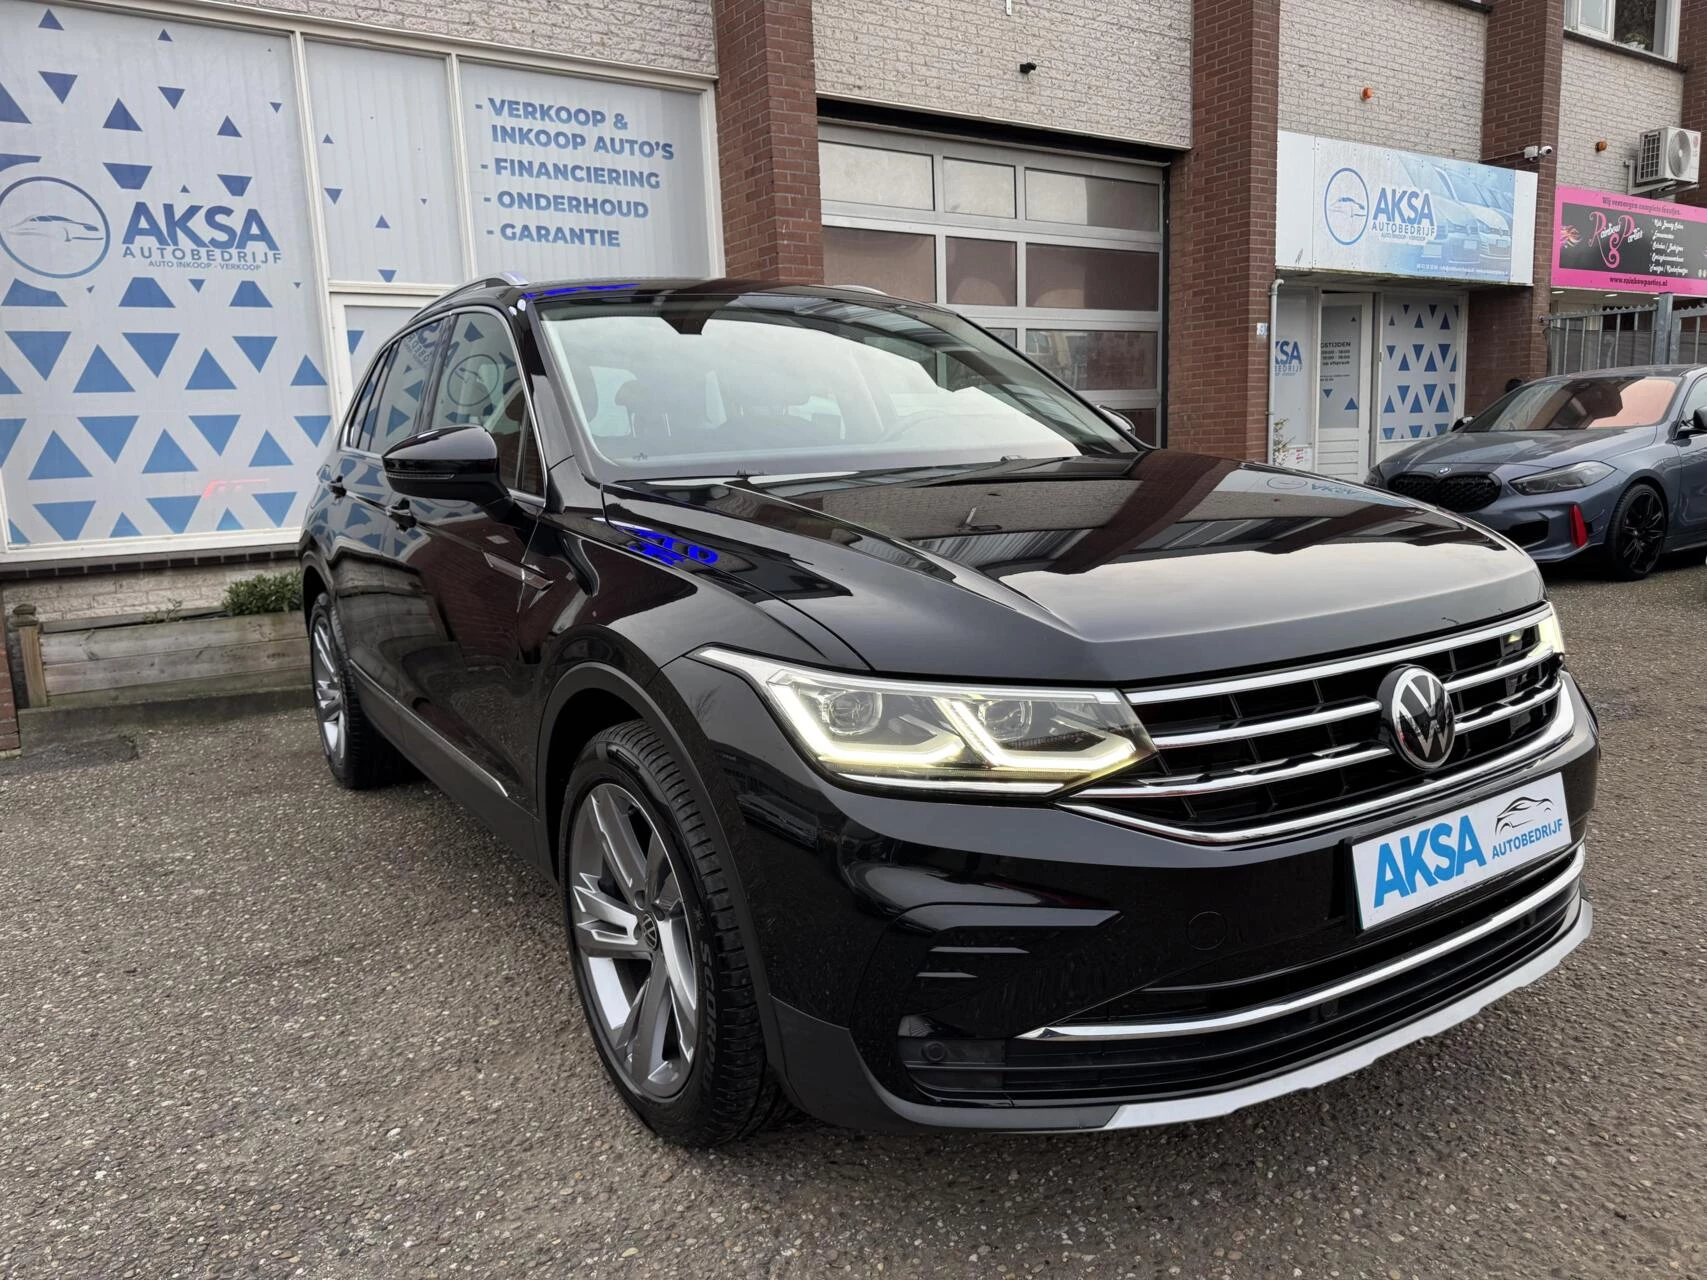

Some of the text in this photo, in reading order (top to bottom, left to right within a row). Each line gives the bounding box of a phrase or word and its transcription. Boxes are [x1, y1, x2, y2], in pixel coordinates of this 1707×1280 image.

[488, 98, 606, 127] VERKOOP
[613, 113, 628, 130] &
[491, 124, 675, 160] INKOOP AUTO'S
[494, 157, 661, 189] FINANCIERING
[497, 190, 649, 218] ONDERHOUD
[1373, 187, 1435, 227] AKSA
[122, 201, 281, 251] AKSA
[500, 223, 621, 247] GARANTIE
[1371, 222, 1436, 237] AUTOBEDRIJF
[122, 246, 283, 264] AUTOBEDRIJF
[148, 260, 174, 268] AUTO
[176, 262, 212, 270] INKOOP
[1373, 815, 1564, 909] AKSA AUTOBEDRIJF
